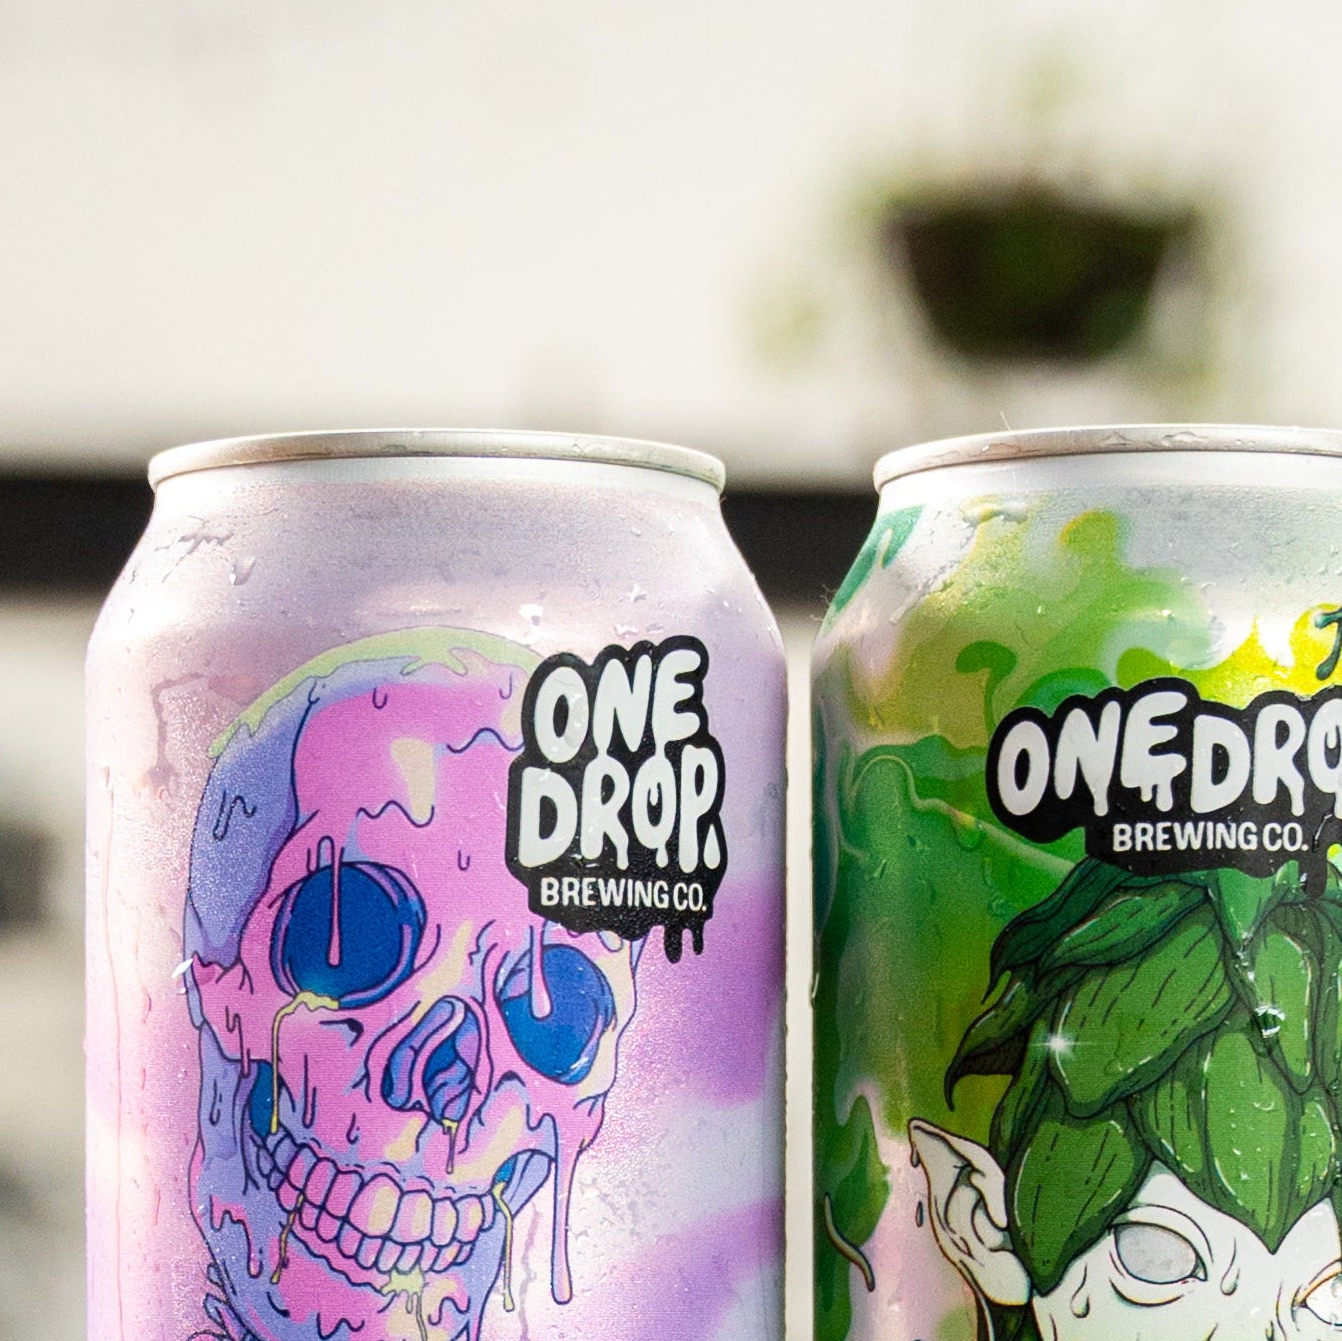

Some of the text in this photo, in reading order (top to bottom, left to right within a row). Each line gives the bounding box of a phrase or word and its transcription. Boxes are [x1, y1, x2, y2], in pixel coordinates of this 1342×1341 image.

[534, 648, 701, 763] ONE
[1113, 820, 1309, 853] BREWING CO.
[540, 877, 708, 912] BREWING CO.
